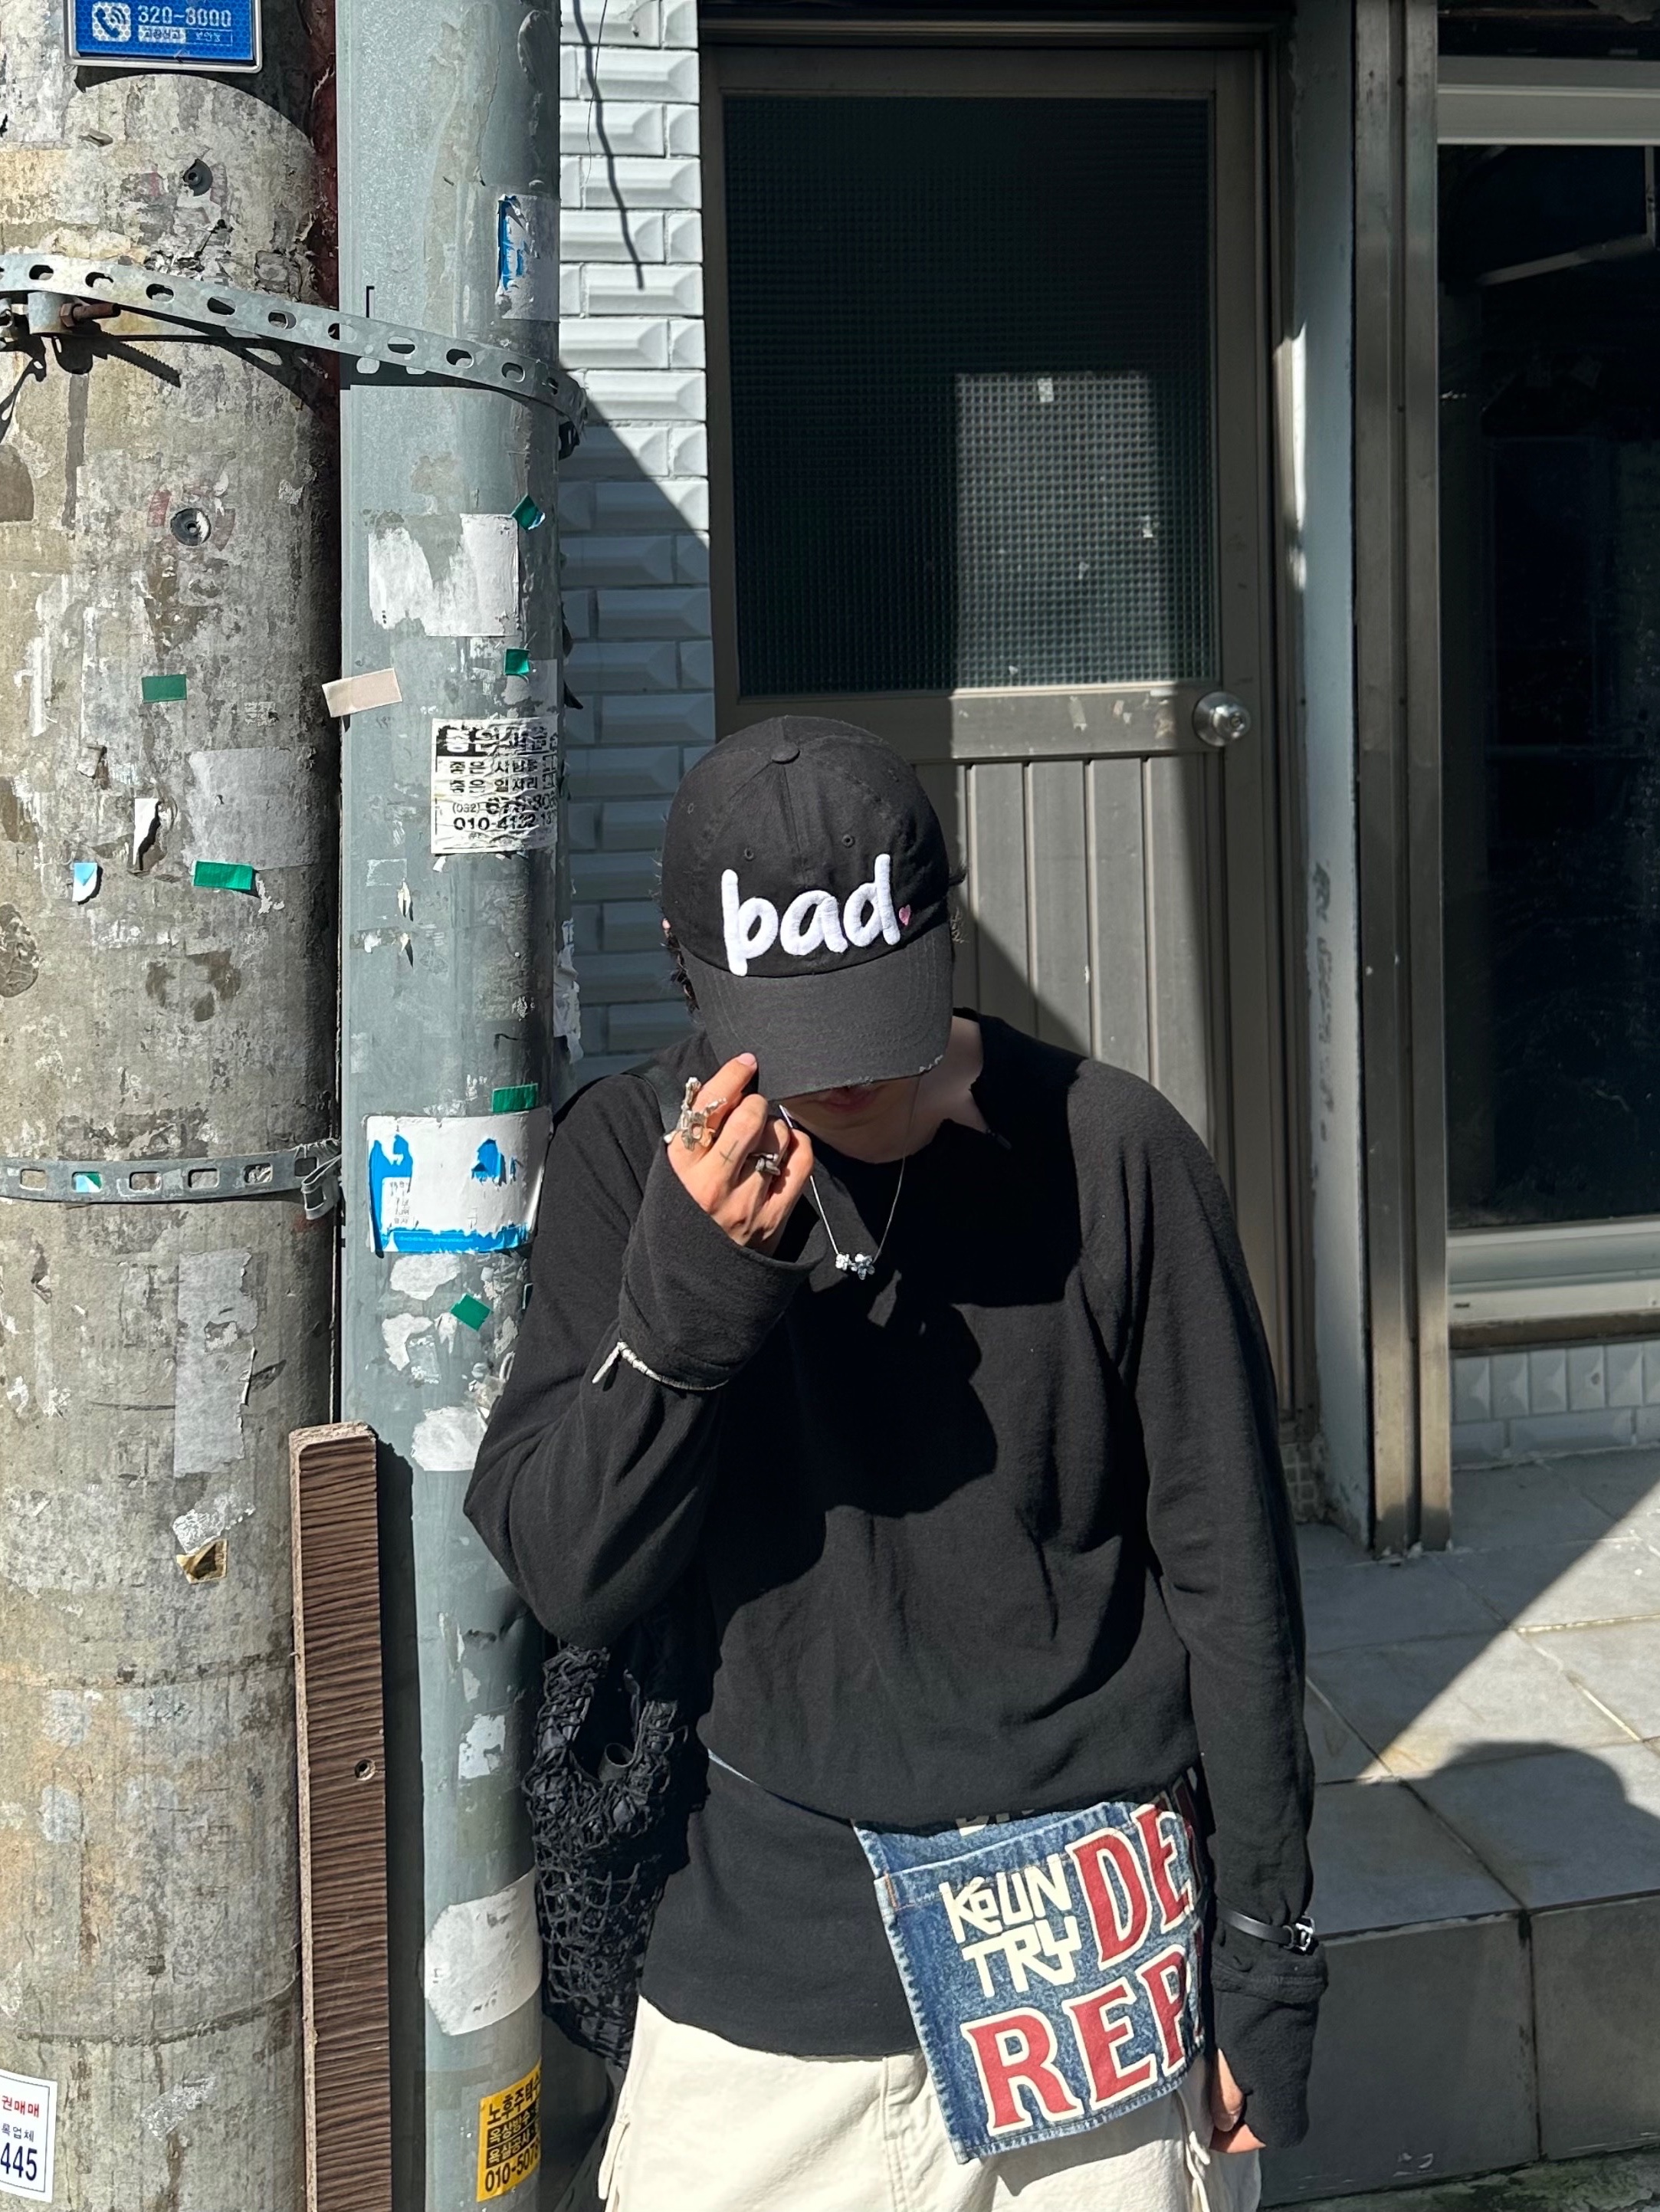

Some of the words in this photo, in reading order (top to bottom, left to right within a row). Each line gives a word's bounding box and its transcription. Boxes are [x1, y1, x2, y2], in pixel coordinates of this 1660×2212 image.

[137, 5, 232, 28] 320-3000
[721, 853, 901, 976] bad
[961, 1915, 1082, 1998] TRY
[0, 2141, 38, 2181] 445
